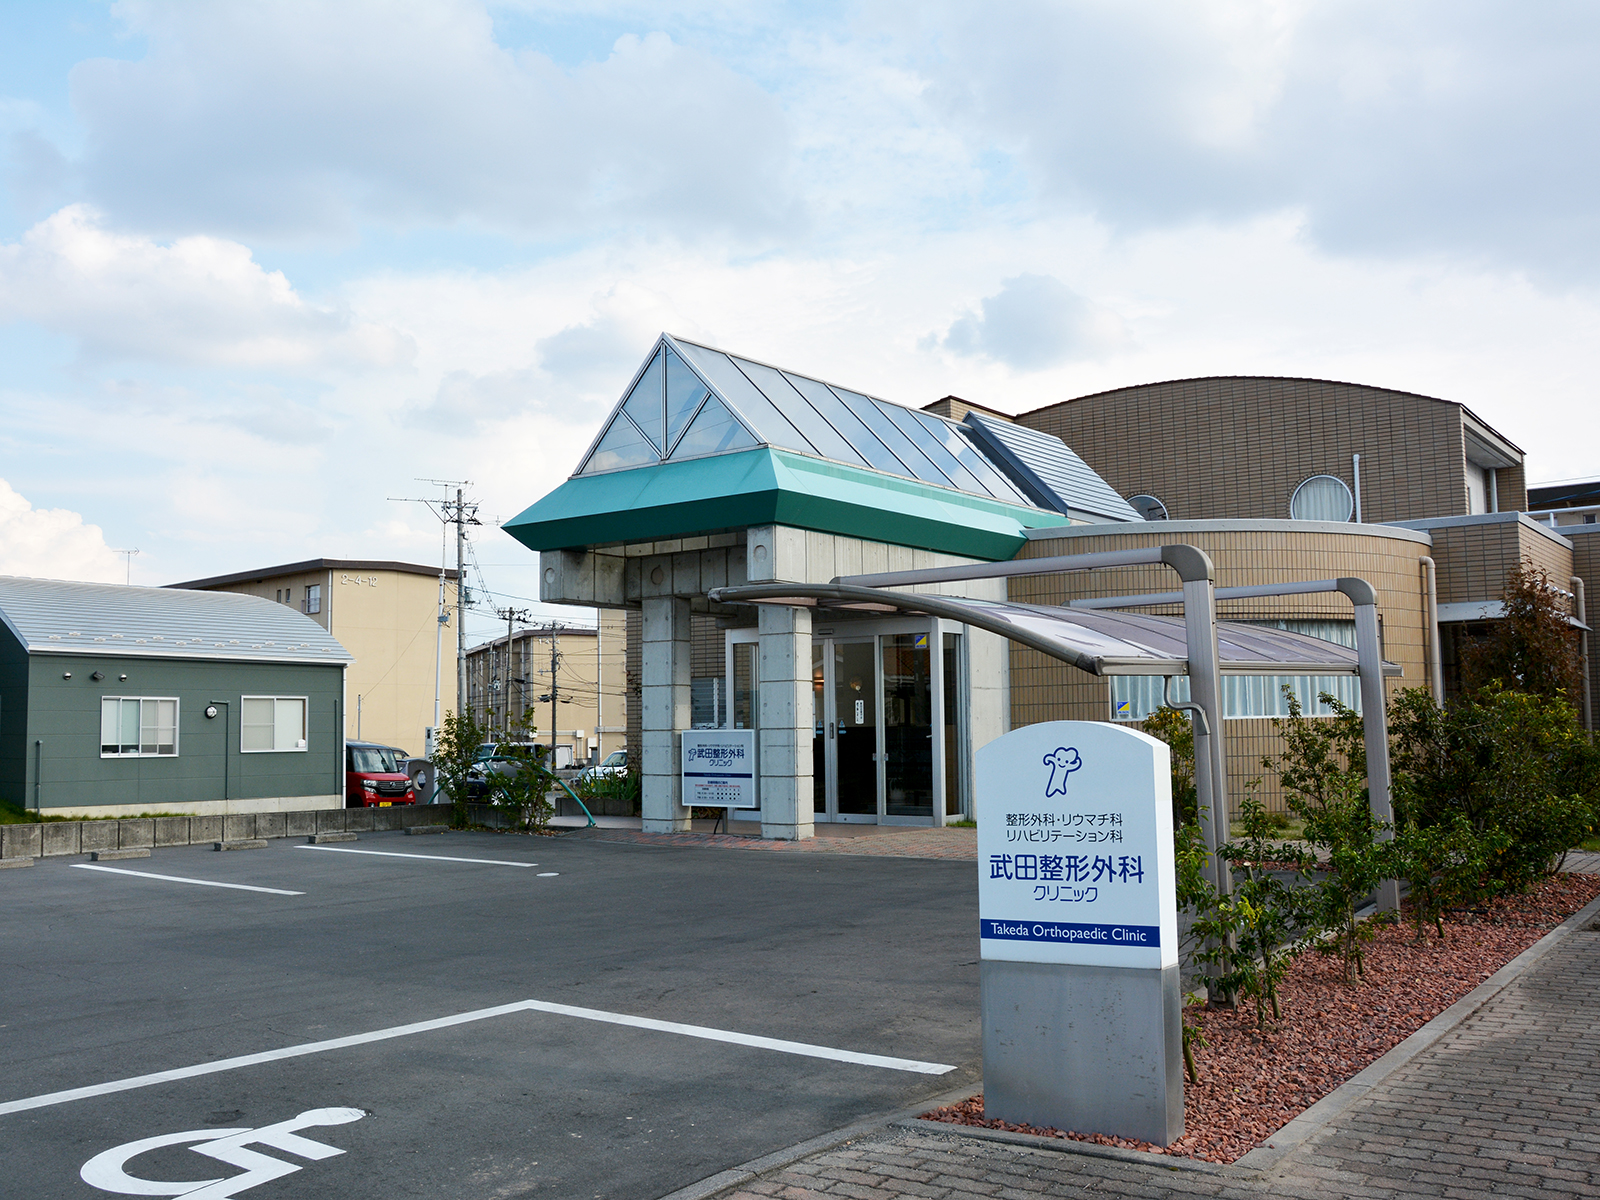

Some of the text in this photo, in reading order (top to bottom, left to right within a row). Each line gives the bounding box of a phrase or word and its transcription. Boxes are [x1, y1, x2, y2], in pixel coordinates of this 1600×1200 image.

[341, 573, 378, 588] 2-4-12
[697, 748, 745, 759] 武田整形外科
[709, 759, 733, 767] クリニック
[1005, 813, 1123, 827] 整形外科・リウマチ科
[1006, 829, 1123, 843] リハビリテーション科
[989, 854, 1145, 884] 武田整形外科
[1033, 885, 1098, 902] クリニック
[990, 922, 1147, 942] Takeda Orthopaedic Clinic
